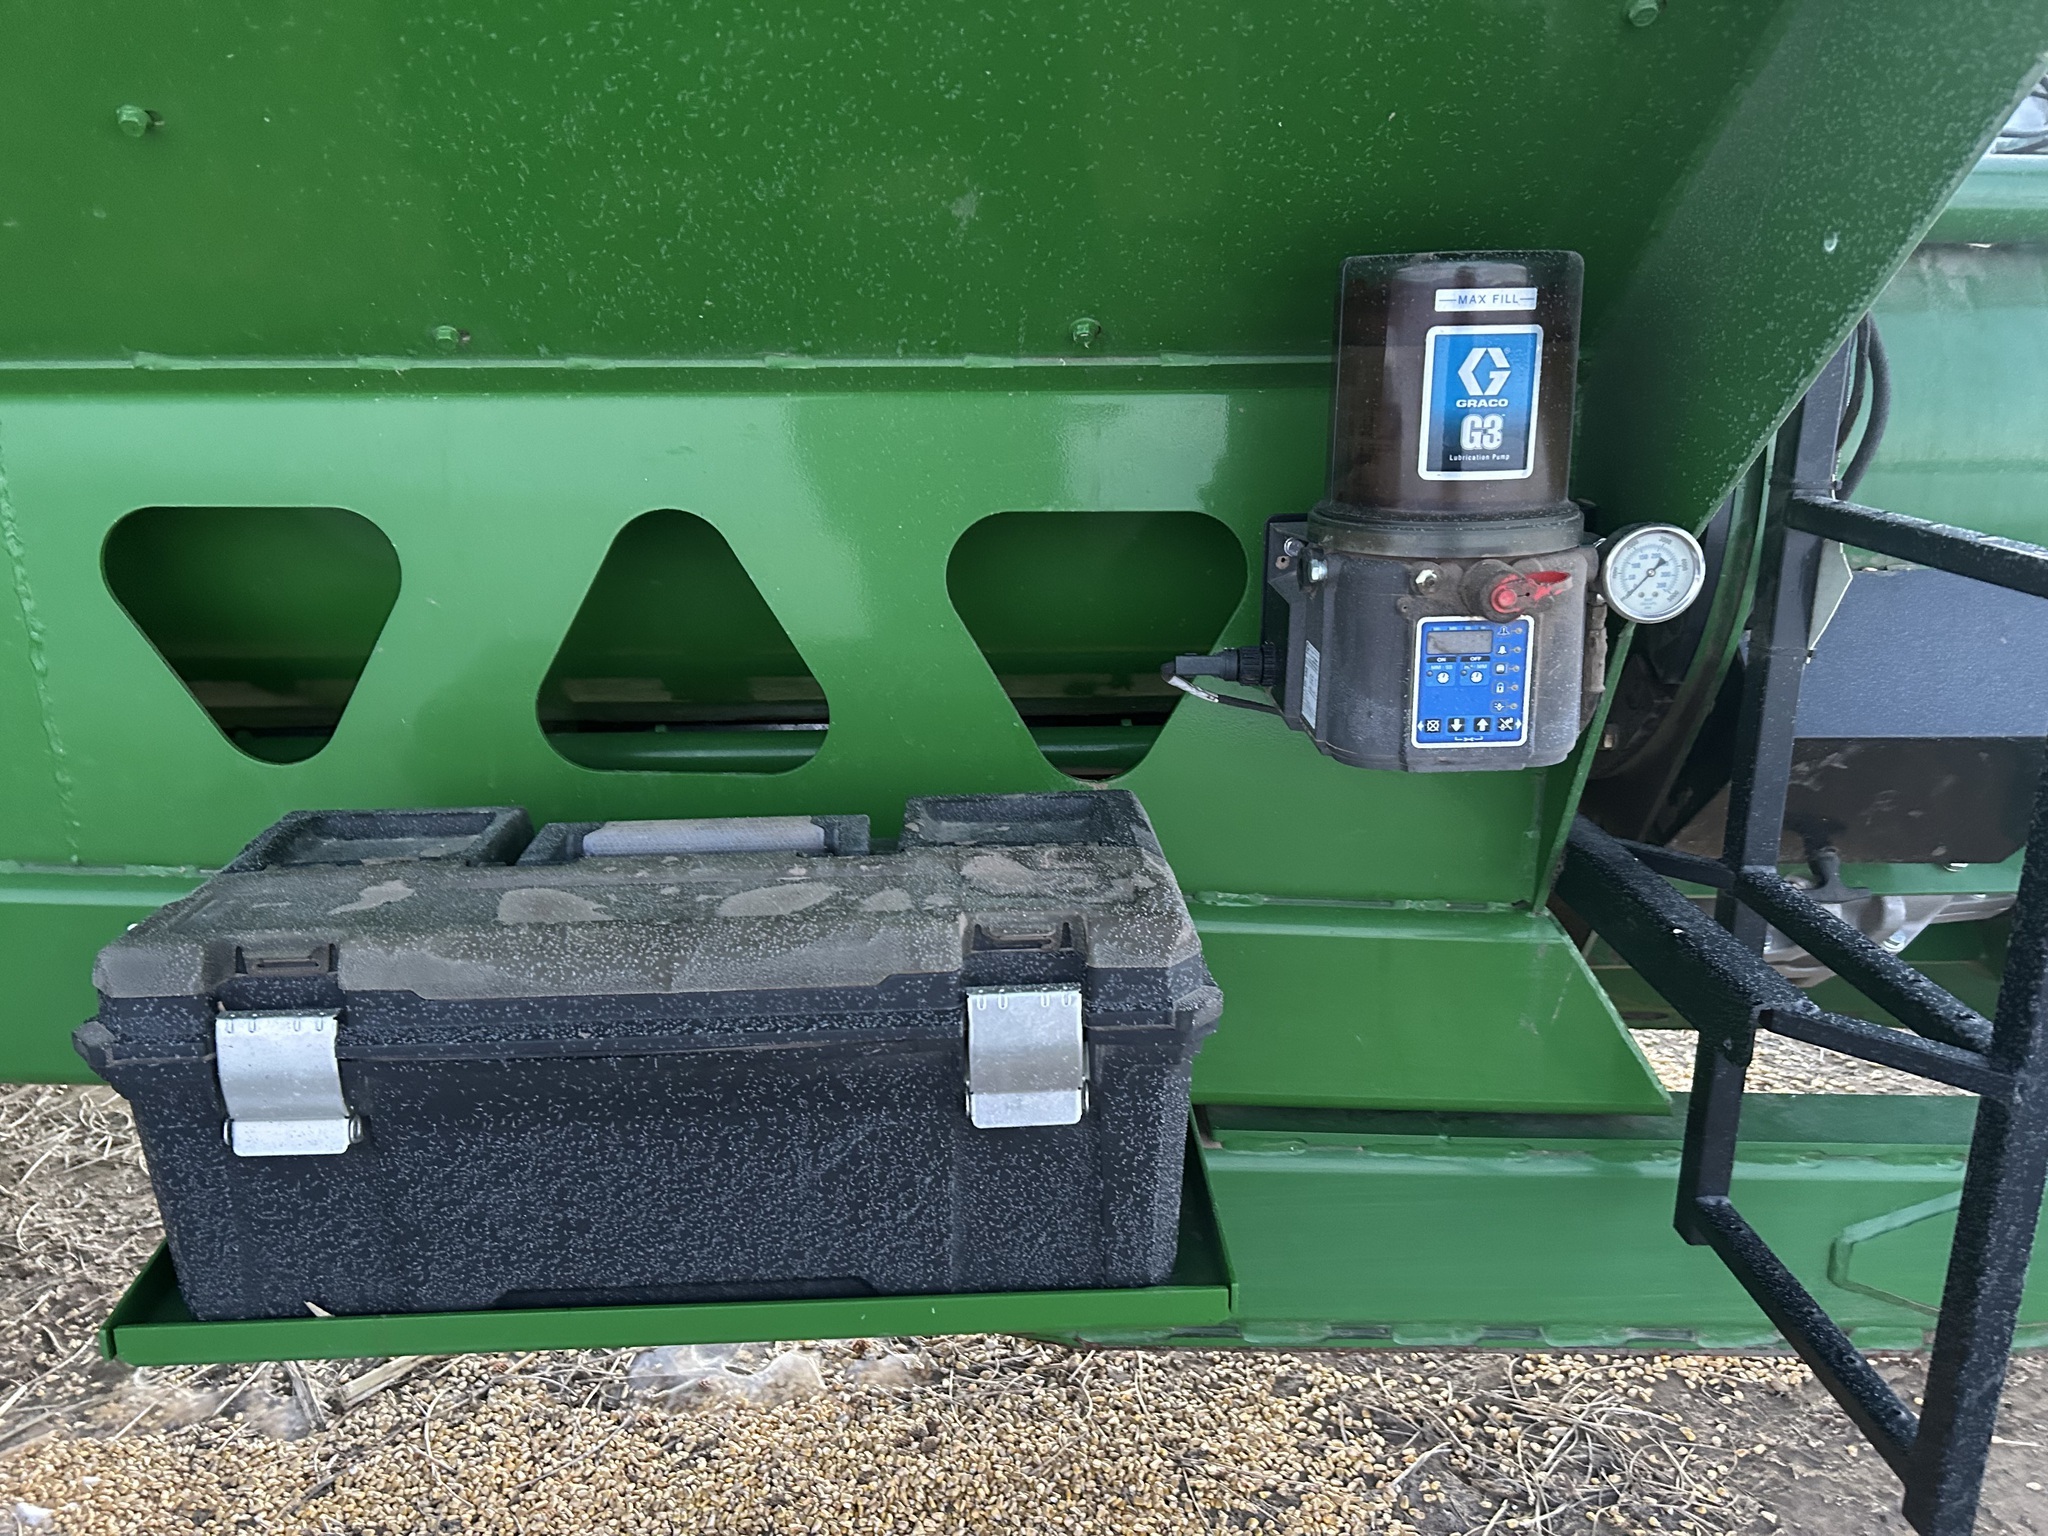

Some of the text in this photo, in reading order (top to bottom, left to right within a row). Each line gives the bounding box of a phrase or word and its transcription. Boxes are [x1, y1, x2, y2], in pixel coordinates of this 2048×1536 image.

[1457, 294, 1519, 305] MAX FILL
[1456, 398, 1509, 408] GRACO
[1460, 413, 1504, 451] G3
[1449, 453, 1510, 462] Lubrication Pump
